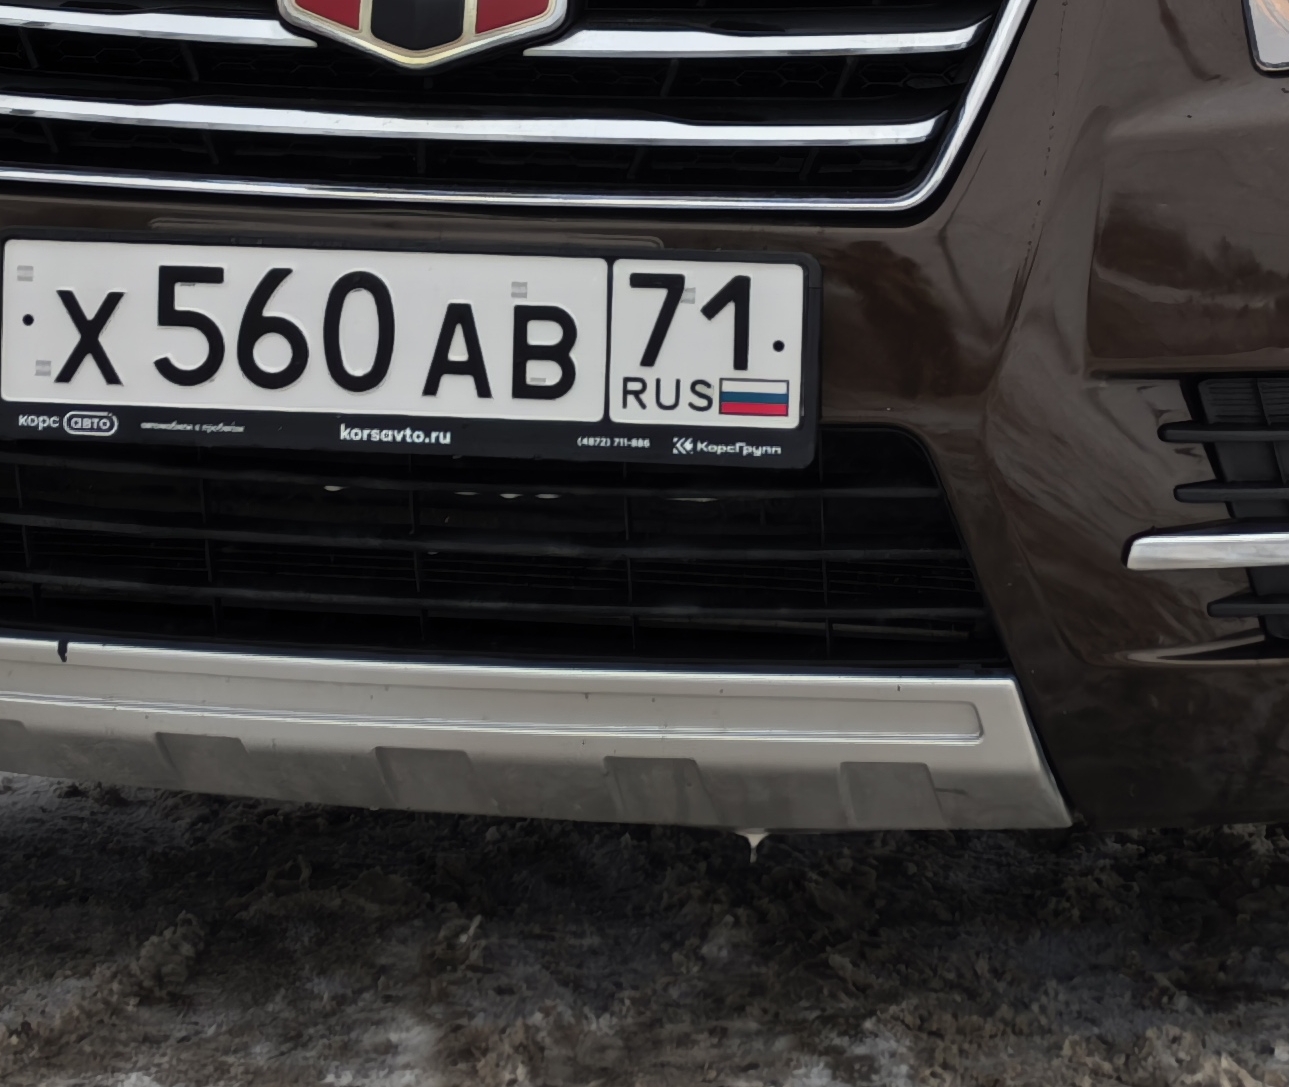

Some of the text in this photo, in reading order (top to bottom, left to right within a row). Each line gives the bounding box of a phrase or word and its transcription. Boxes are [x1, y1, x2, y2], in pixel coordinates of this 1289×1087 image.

[628, 272, 751, 372] 71
[622, 377, 714, 412] RUS
[18, 414, 111, 431] корс авто
[339, 422, 452, 445] korsavto.ru
[696, 440, 782, 456] КорсГрупп
